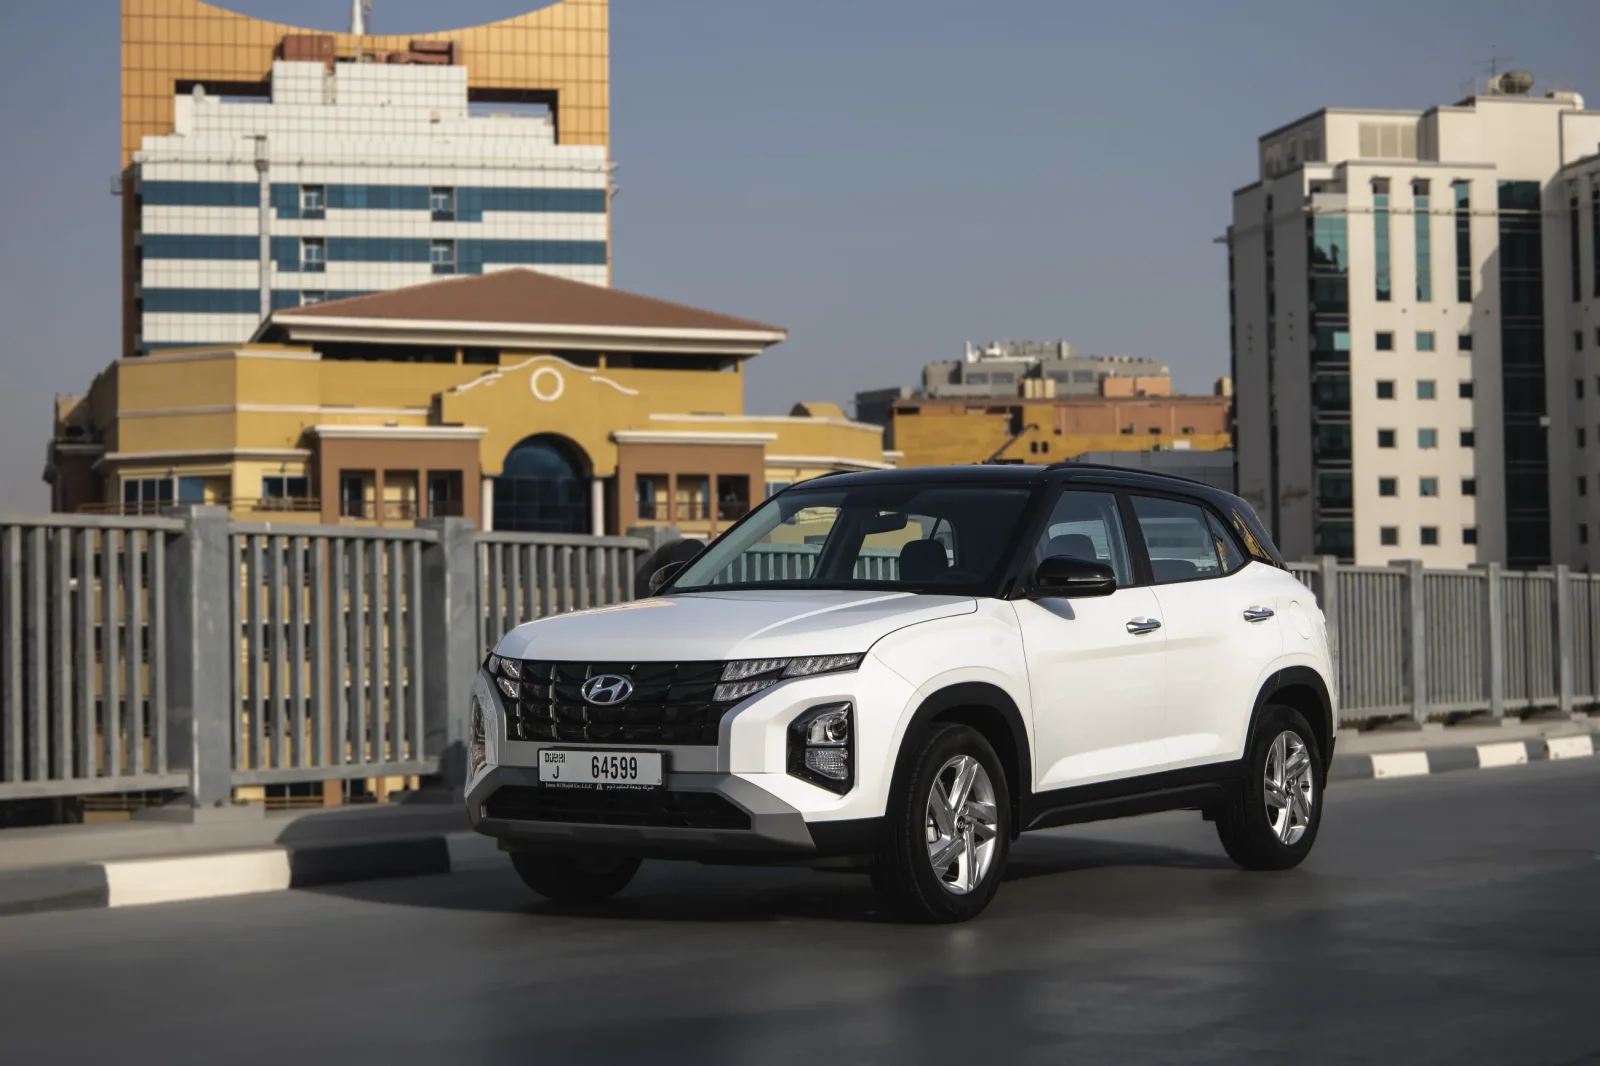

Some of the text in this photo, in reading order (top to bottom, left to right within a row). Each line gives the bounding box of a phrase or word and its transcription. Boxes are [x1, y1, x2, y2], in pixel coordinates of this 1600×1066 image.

[545, 752, 566, 764] DUBAI
[552, 755, 638, 780] J 64599
